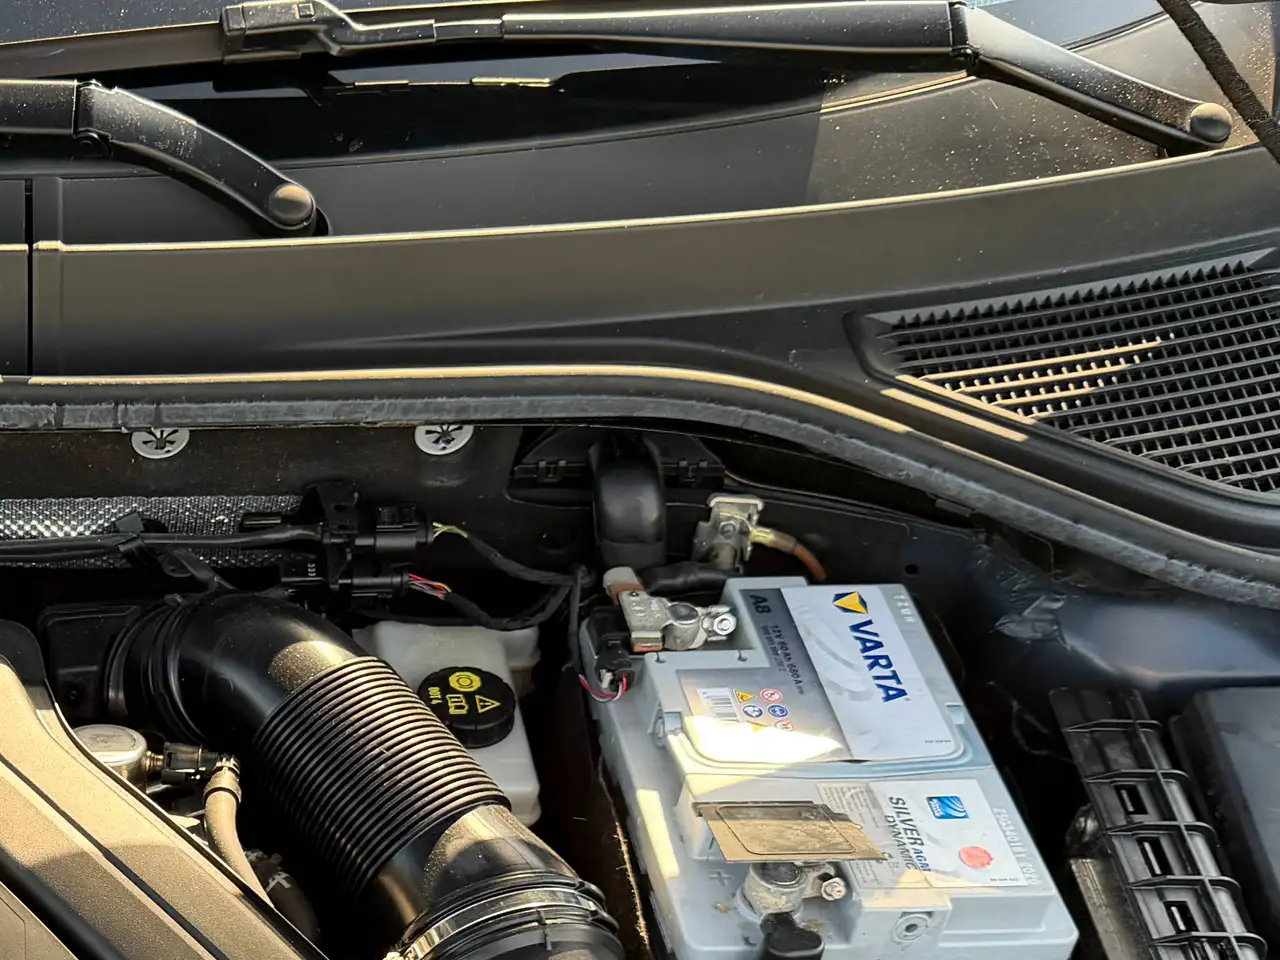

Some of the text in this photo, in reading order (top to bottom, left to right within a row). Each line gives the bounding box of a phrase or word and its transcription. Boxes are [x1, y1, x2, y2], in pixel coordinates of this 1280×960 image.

[750, 594, 772, 614] A8
[848, 619, 908, 703] VARTA
[428, 687, 441, 699] DOT
[884, 815, 920, 870] DYNAMIC
[888, 796, 932, 871] SILVER AGM
